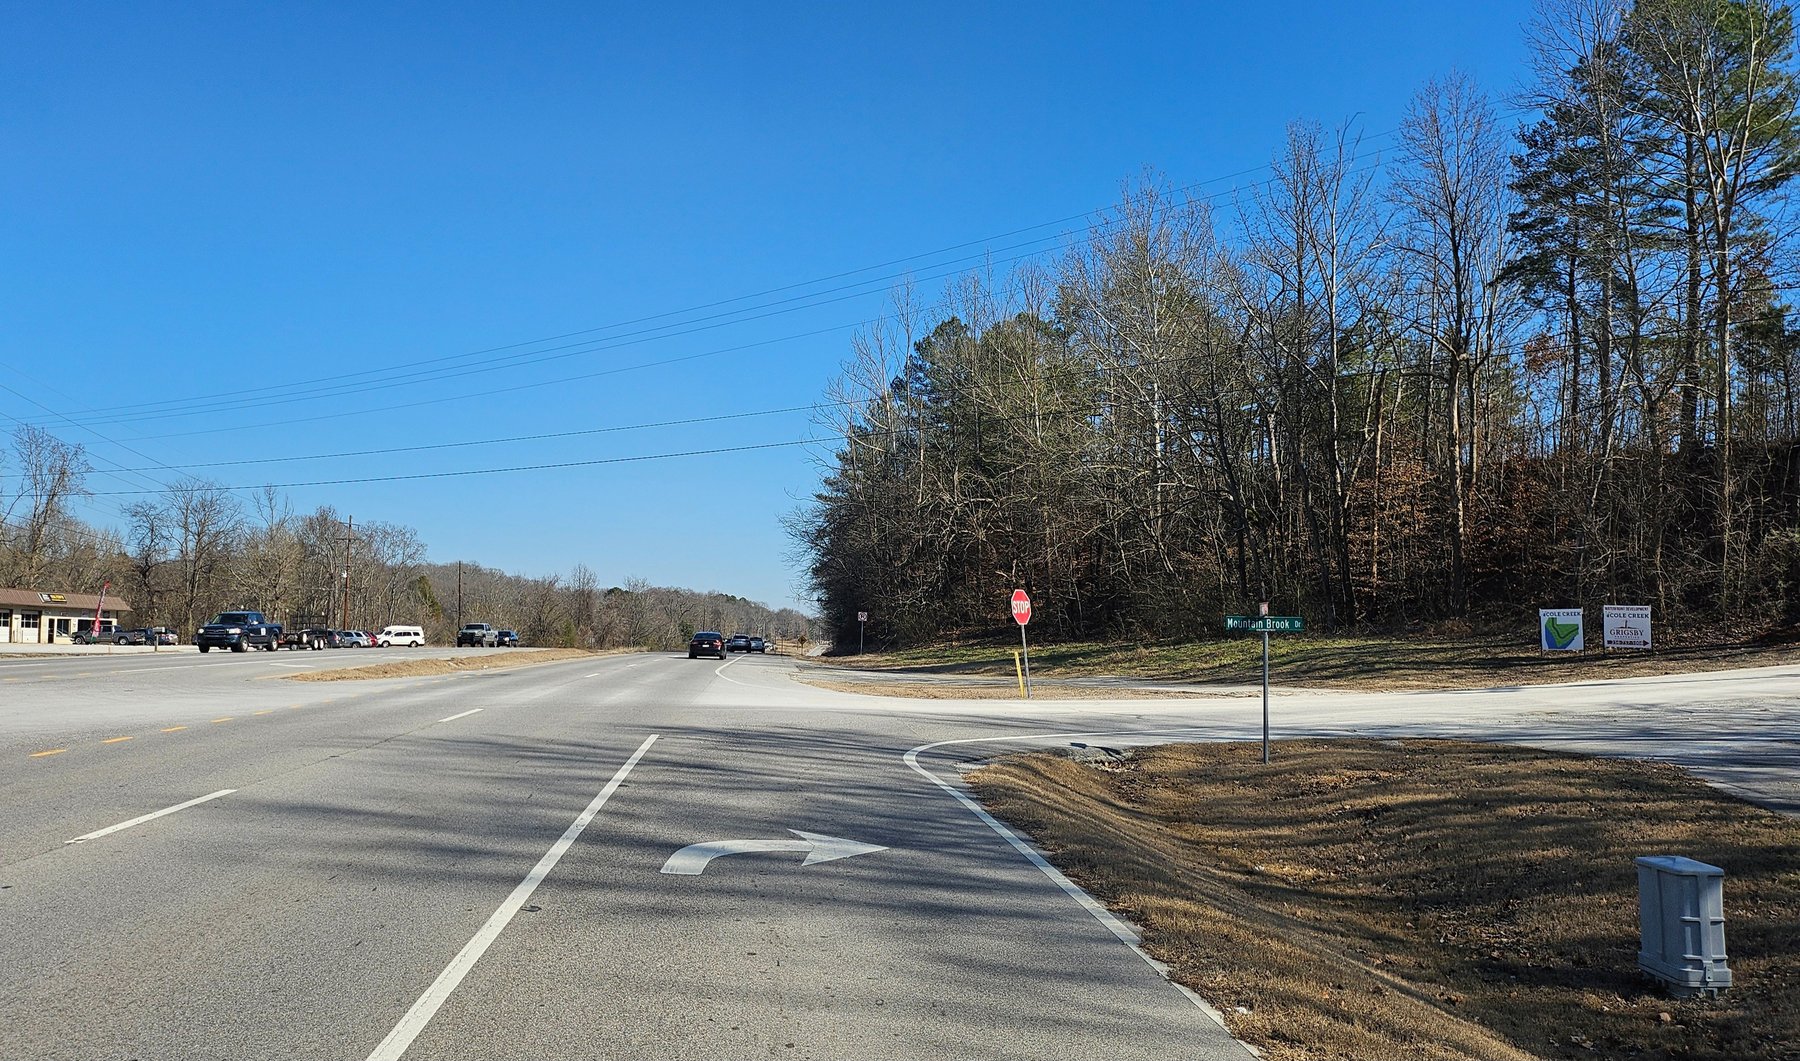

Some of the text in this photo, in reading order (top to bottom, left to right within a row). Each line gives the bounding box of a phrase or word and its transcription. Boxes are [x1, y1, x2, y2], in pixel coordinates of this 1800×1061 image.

[1012, 600, 1028, 614] STOP
[1227, 618, 1263, 628] Mountain
[1266, 619, 1289, 629] Brook
